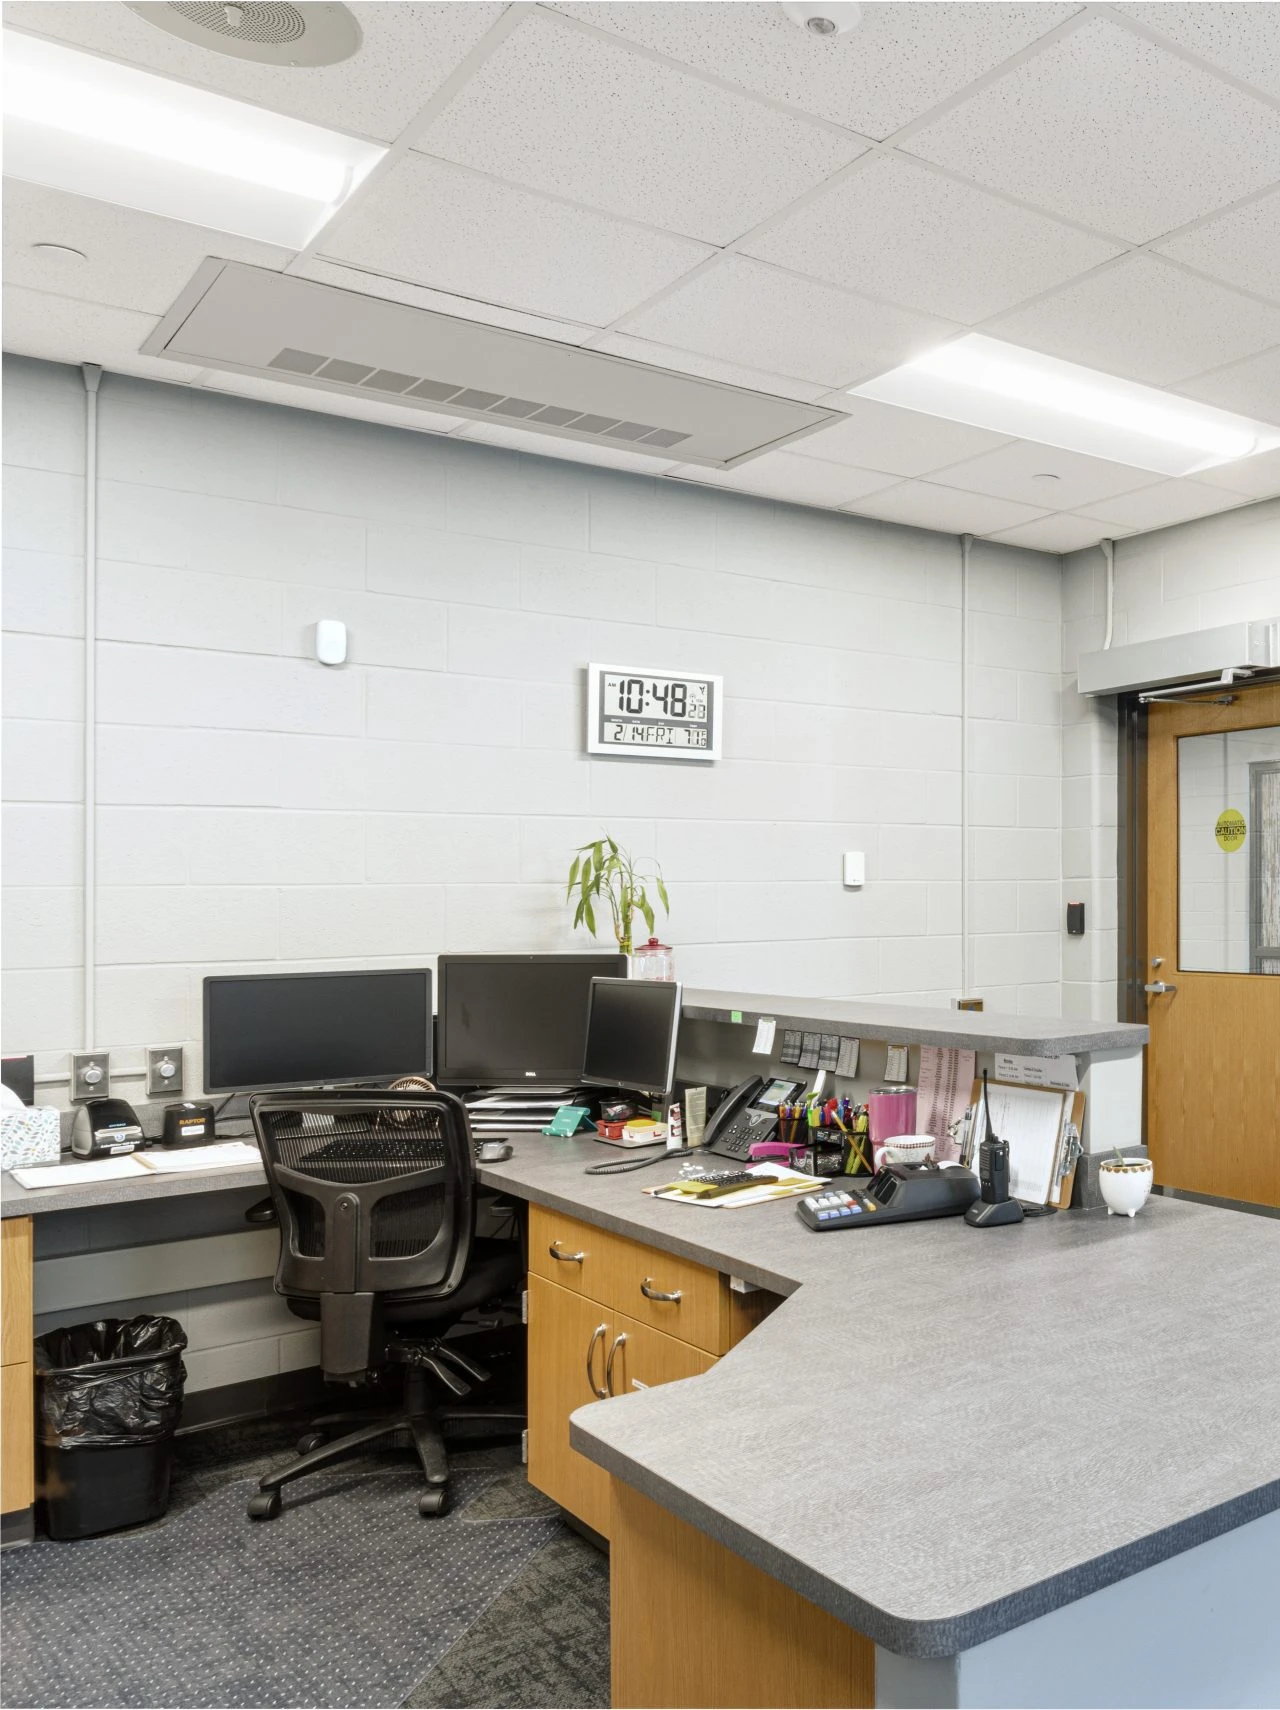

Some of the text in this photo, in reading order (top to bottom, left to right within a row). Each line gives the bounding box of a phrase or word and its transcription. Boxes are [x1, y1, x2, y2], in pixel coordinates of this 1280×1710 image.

[618, 679, 687, 718] 10:48
[646, 726, 674, 744] FRI
[1216, 826, 1246, 836] CAUTION
